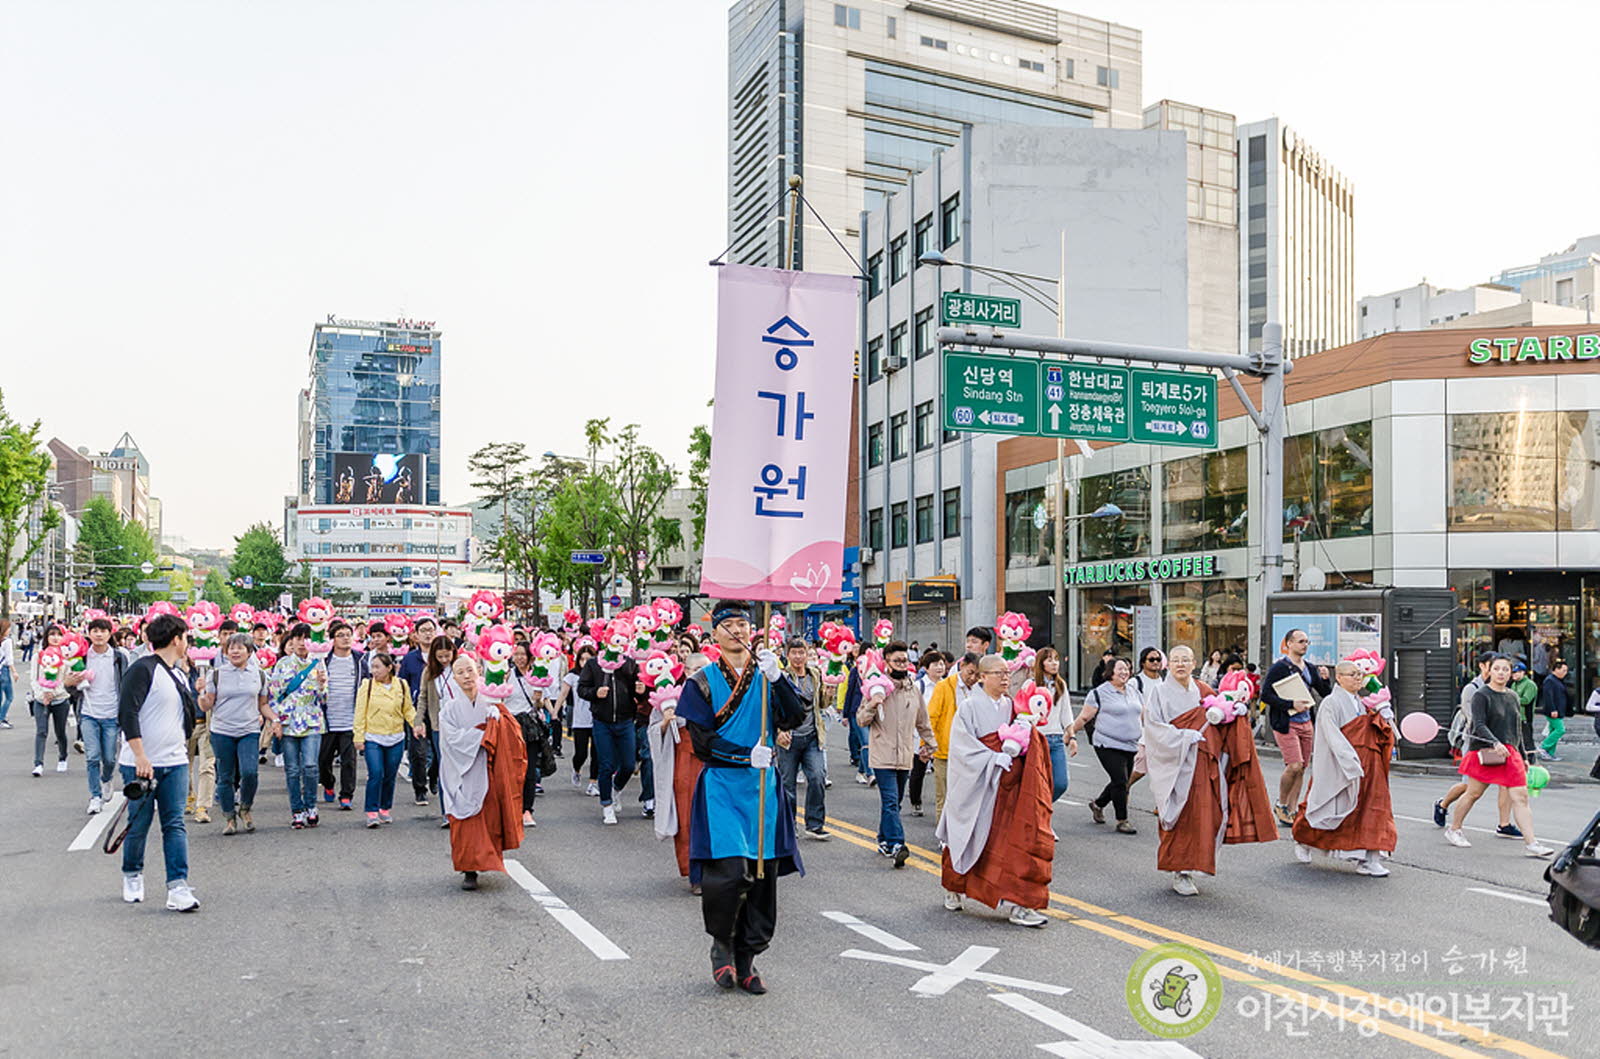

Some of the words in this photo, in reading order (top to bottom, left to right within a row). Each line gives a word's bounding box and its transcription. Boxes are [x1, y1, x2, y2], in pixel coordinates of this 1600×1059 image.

[948, 298, 1016, 323] 광희사거리
[1469, 334, 1600, 364] STARB
[963, 365, 1013, 388] 신당역
[1068, 370, 1125, 391] 한남대교
[963, 386, 1004, 404] Sindang
[1006, 389, 1024, 403] Stn
[1049, 387, 1061, 398] 41
[1141, 380, 1208, 403] 퇴계로5가
[753, 315, 815, 518] 승가원
[957, 409, 971, 423] 60
[1069, 403, 1125, 424] 장충체육관
[1141, 400, 1178, 416] Toegyero
[1193, 424, 1205, 435] 41
[1148, 556, 1214, 579] COFFEE
